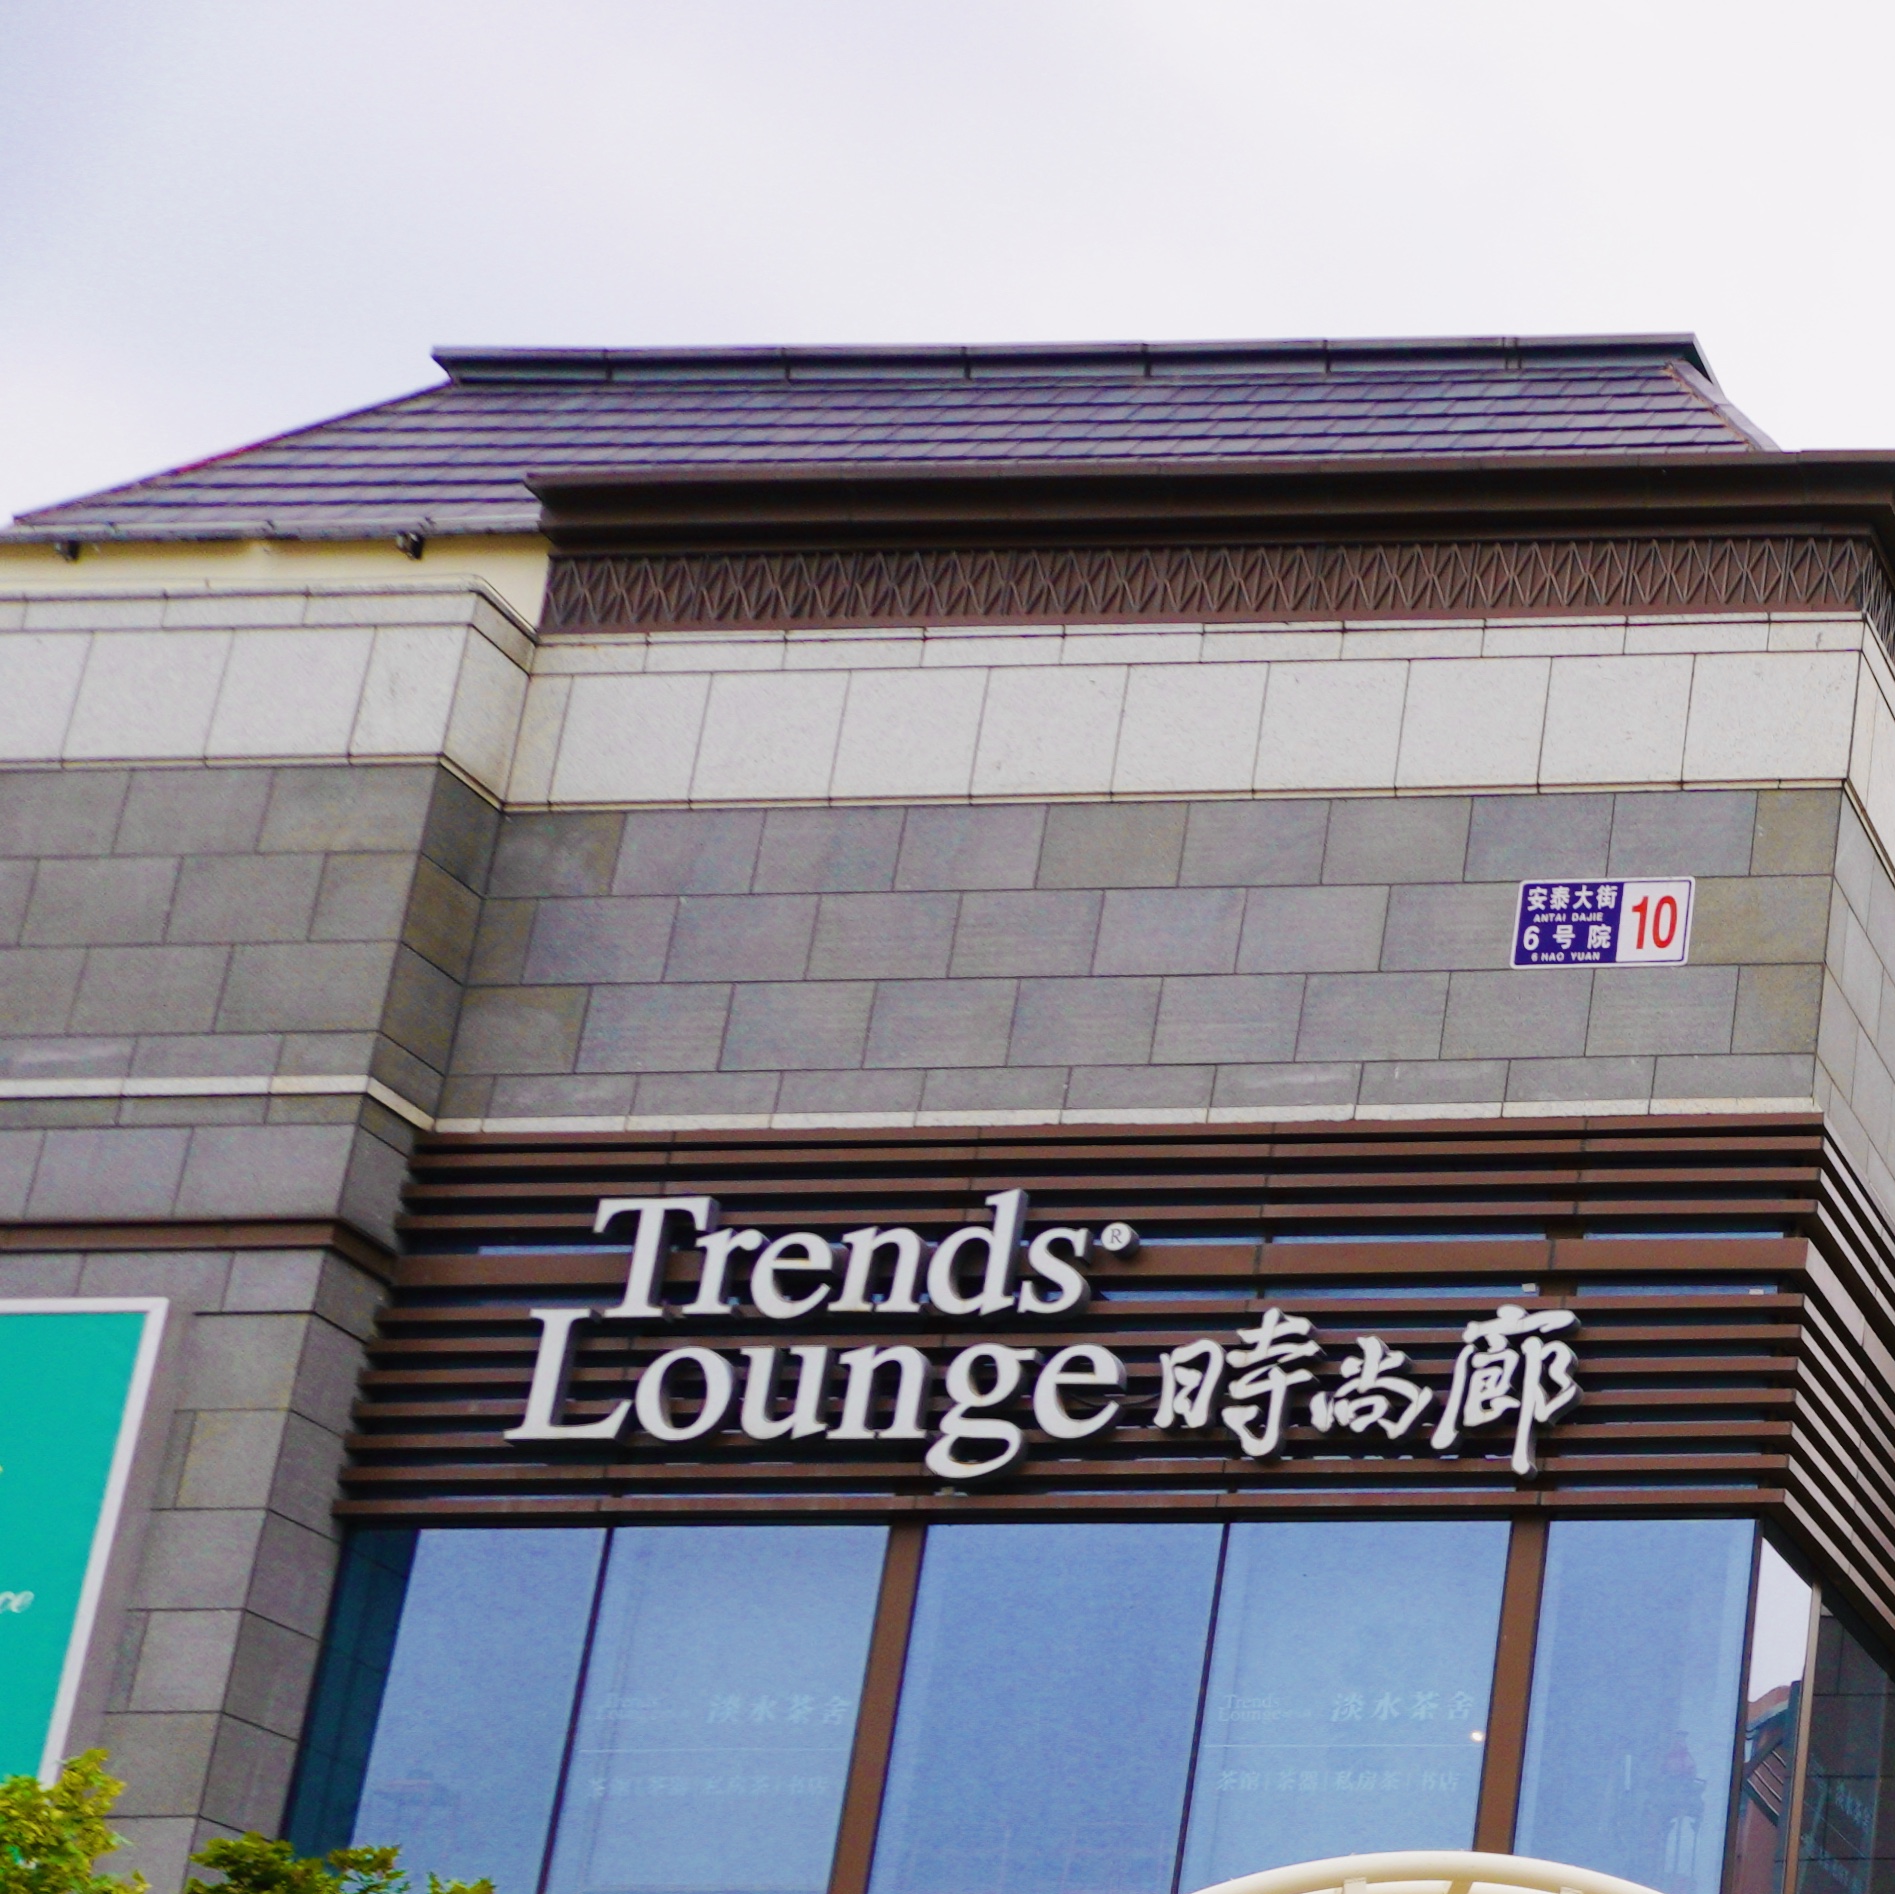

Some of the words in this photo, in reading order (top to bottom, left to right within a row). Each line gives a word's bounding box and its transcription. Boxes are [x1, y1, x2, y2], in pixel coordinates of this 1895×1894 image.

[1527, 885, 1619, 912] 安泰大街
[1533, 913, 1567, 923] ANTAI
[1571, 912, 1604, 922] DAJIE
[1631, 895, 1678, 950] 10
[1570, 952, 1601, 962] YUAN
[593, 1187, 1095, 1321] Trends
[504, 1307, 1128, 1479] Lounge
[1153, 1303, 1582, 1477] 時尚廊
